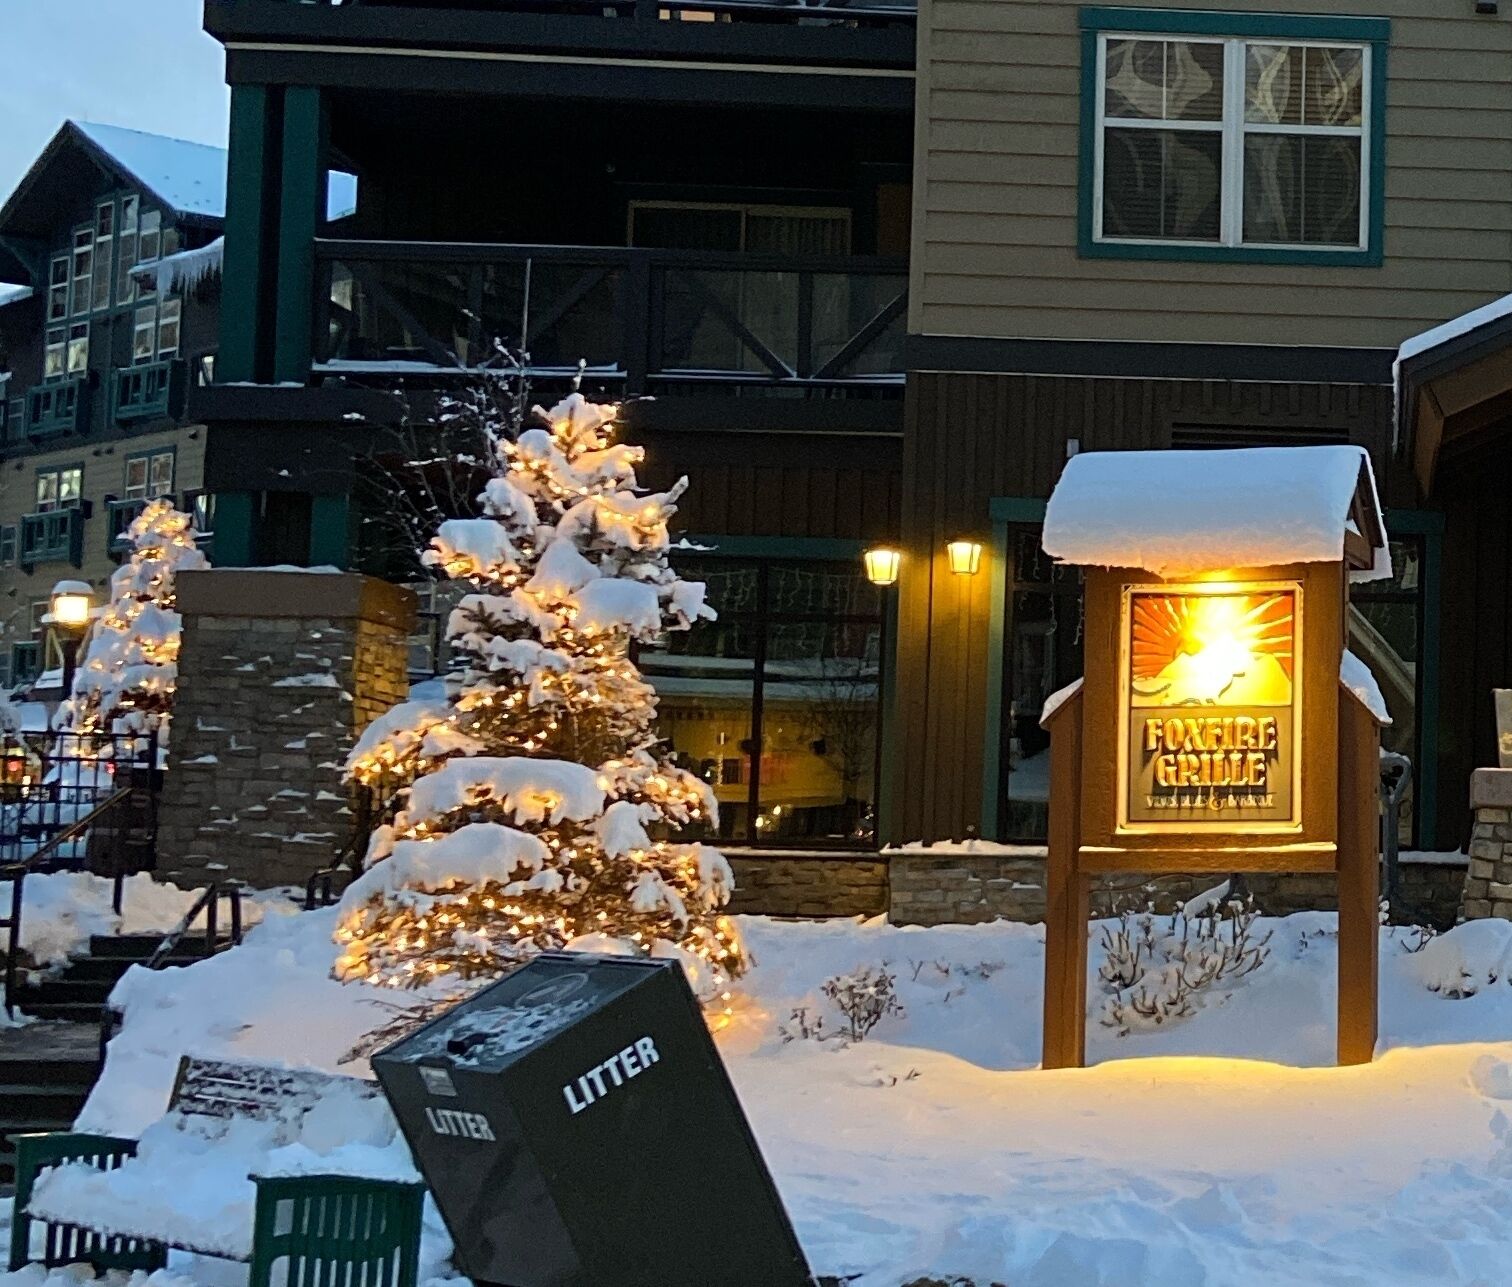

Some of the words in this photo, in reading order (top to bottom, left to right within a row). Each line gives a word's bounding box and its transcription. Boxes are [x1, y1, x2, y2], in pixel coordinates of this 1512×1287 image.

[1145, 716, 1277, 751] FOXFIRE
[1155, 752, 1266, 787] GRILLE
[562, 1035, 661, 1116] LITTER
[425, 1106, 497, 1142] LITTER
